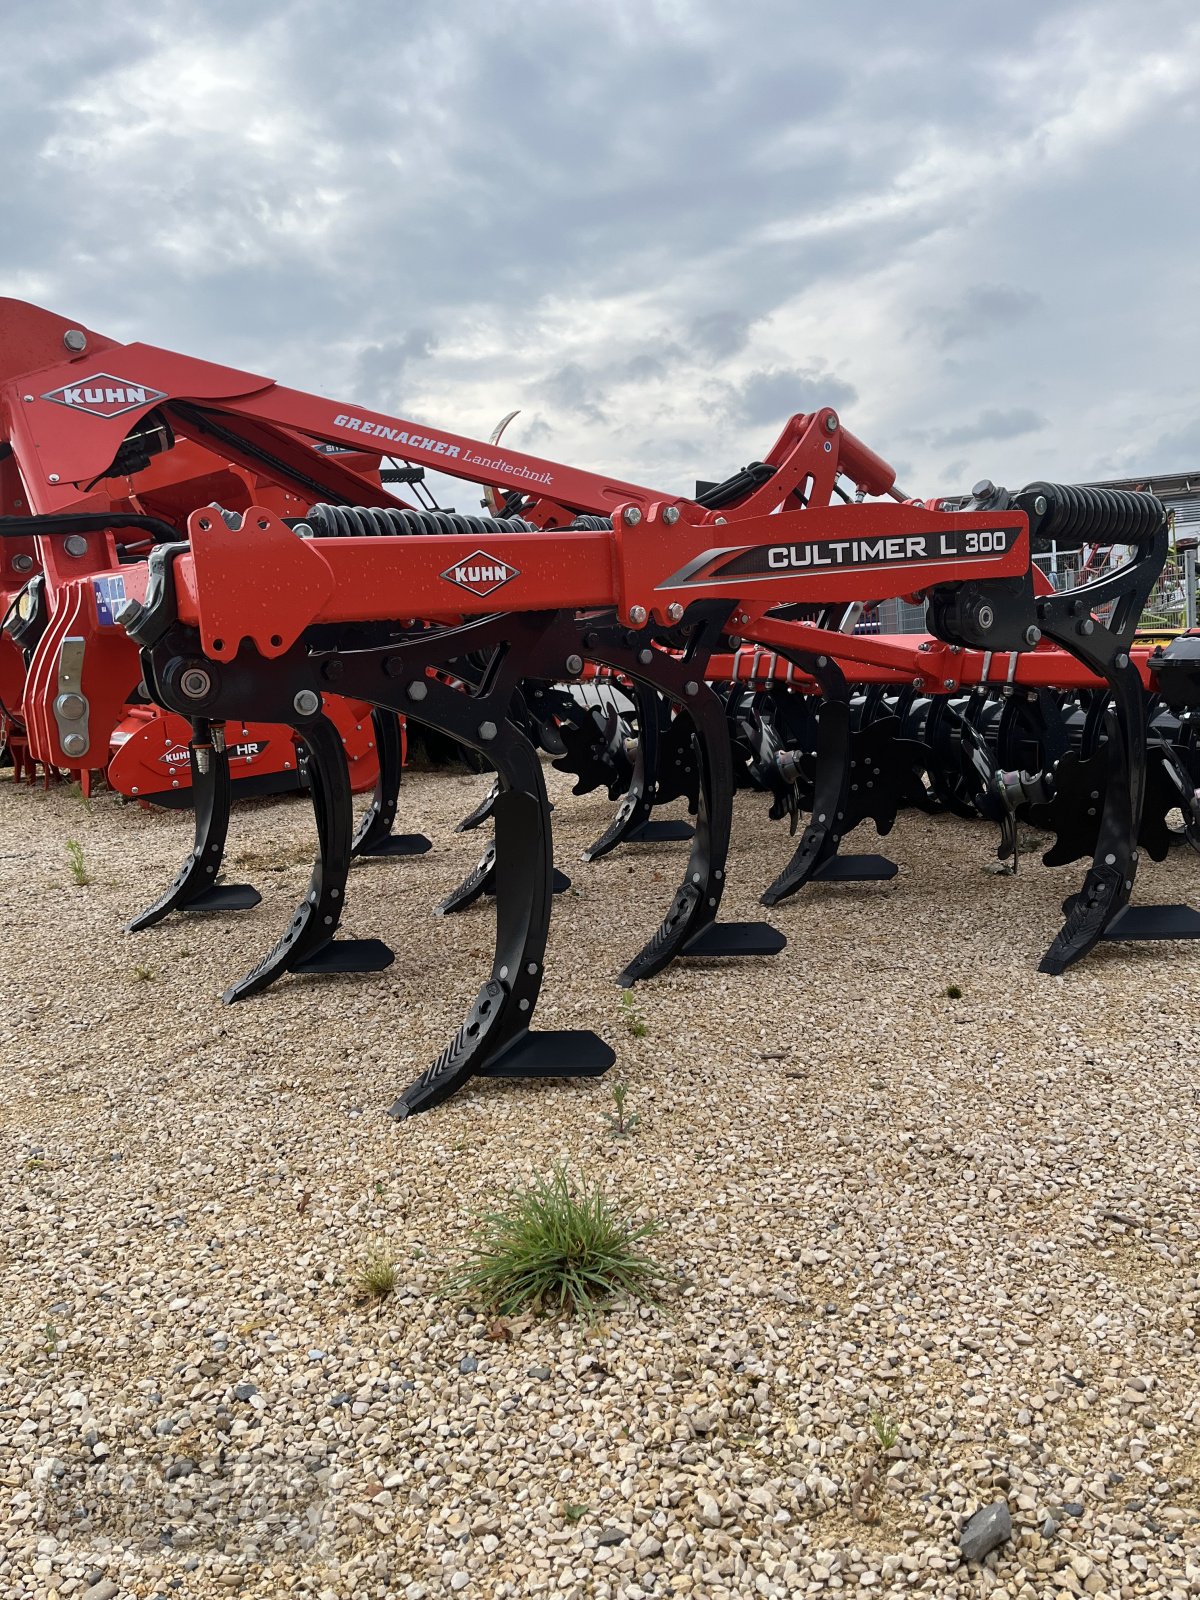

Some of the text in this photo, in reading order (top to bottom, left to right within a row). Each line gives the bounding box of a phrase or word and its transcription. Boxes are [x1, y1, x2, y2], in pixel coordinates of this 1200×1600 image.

[64, 387, 146, 405] KUHN
[333, 414, 554, 485] GREINACHER Landtechnik
[768, 531, 1006, 569] CULTIMER L 300
[454, 565, 507, 583] KUHN
[165, 752, 191, 762] KUH
[236, 743, 259, 756] HR
